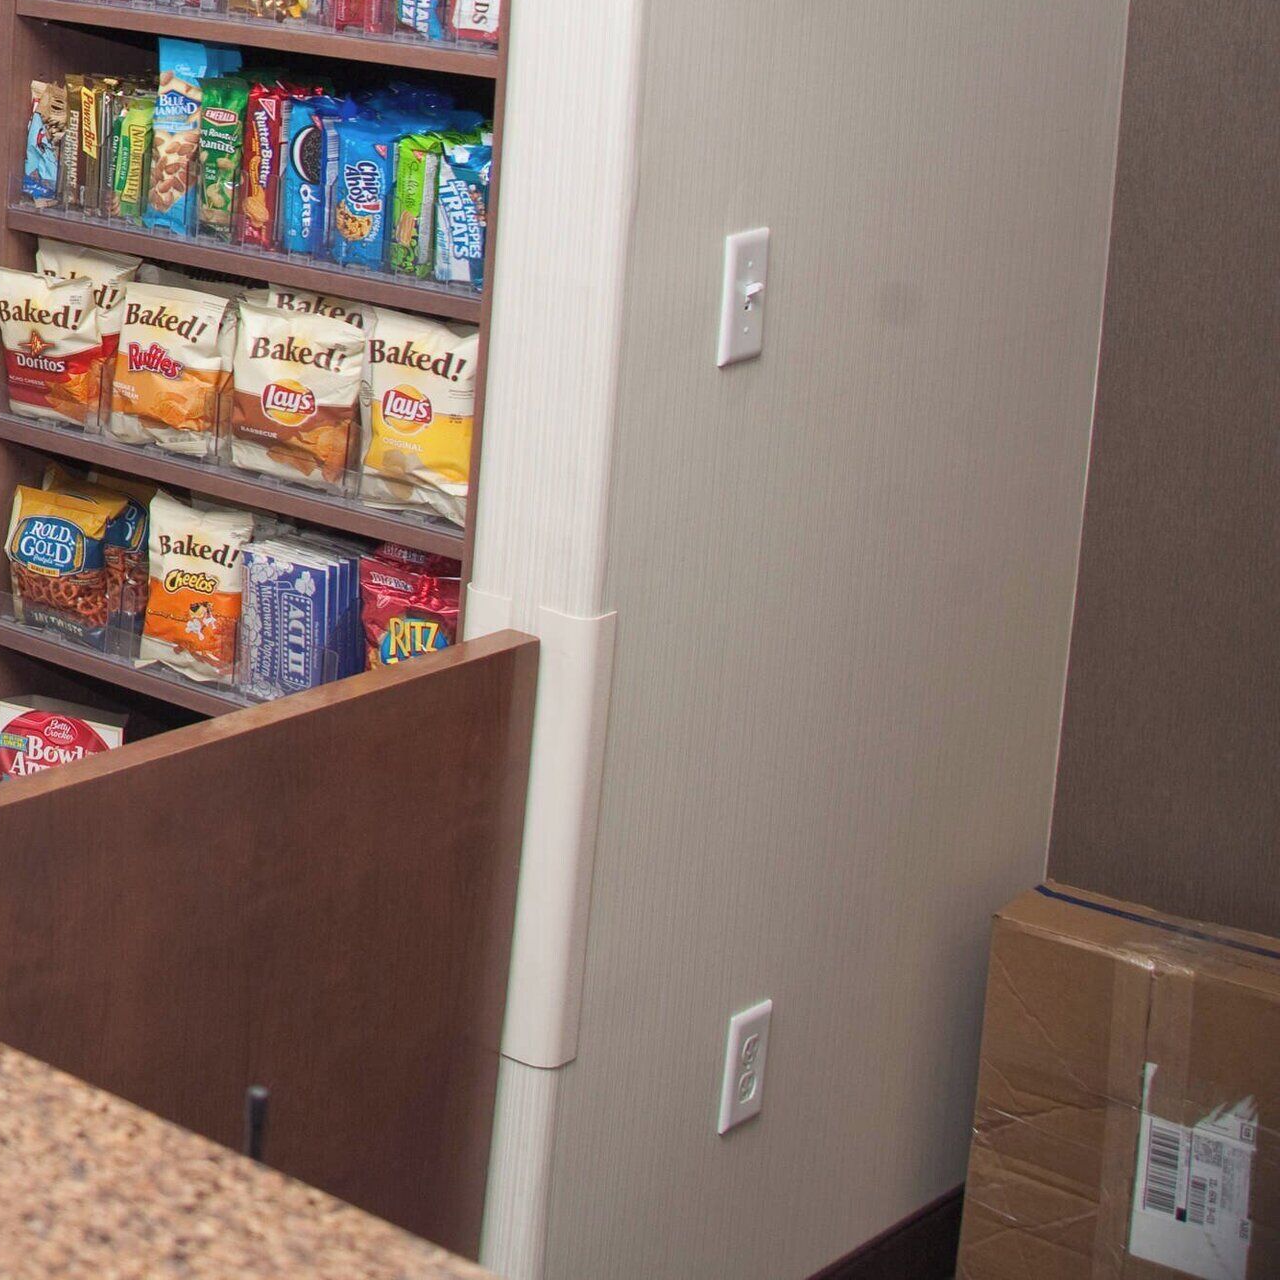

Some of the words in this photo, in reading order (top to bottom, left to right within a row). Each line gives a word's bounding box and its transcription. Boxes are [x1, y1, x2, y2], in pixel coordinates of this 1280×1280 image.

[160, 94, 184, 107] BLUE
[205, 110, 235, 122] EMERALD
[300, 184, 317, 238] OREO
[440, 181, 468, 258] TREATS
[454, 180, 473, 205] RICE
[464, 206, 481, 259] KRISPIES
[125, 303, 207, 343] Baked!
[16, 353, 65, 372] Doritos
[128, 342, 182, 379] Ruffles
[250, 336, 347, 373] Baked!
[369, 339, 467, 382] Baked!
[266, 385, 313, 413] Lay's
[385, 391, 429, 420] Lay's
[240, 426, 278, 439] BARBECUE
[383, 437, 423, 451] ORIGINAL
[30, 520, 70, 542] ROLD
[20, 536, 72, 564] GOLD
[159, 534, 240, 568] Baked!
[165, 569, 217, 593] Cheetos
[260, 586, 273, 638] Microwave
[389, 617, 439, 658] RITZ
[261, 640, 274, 677] Popcorn
[44, 726, 74, 740] Crocker
[51, 720, 71, 733] Betty
